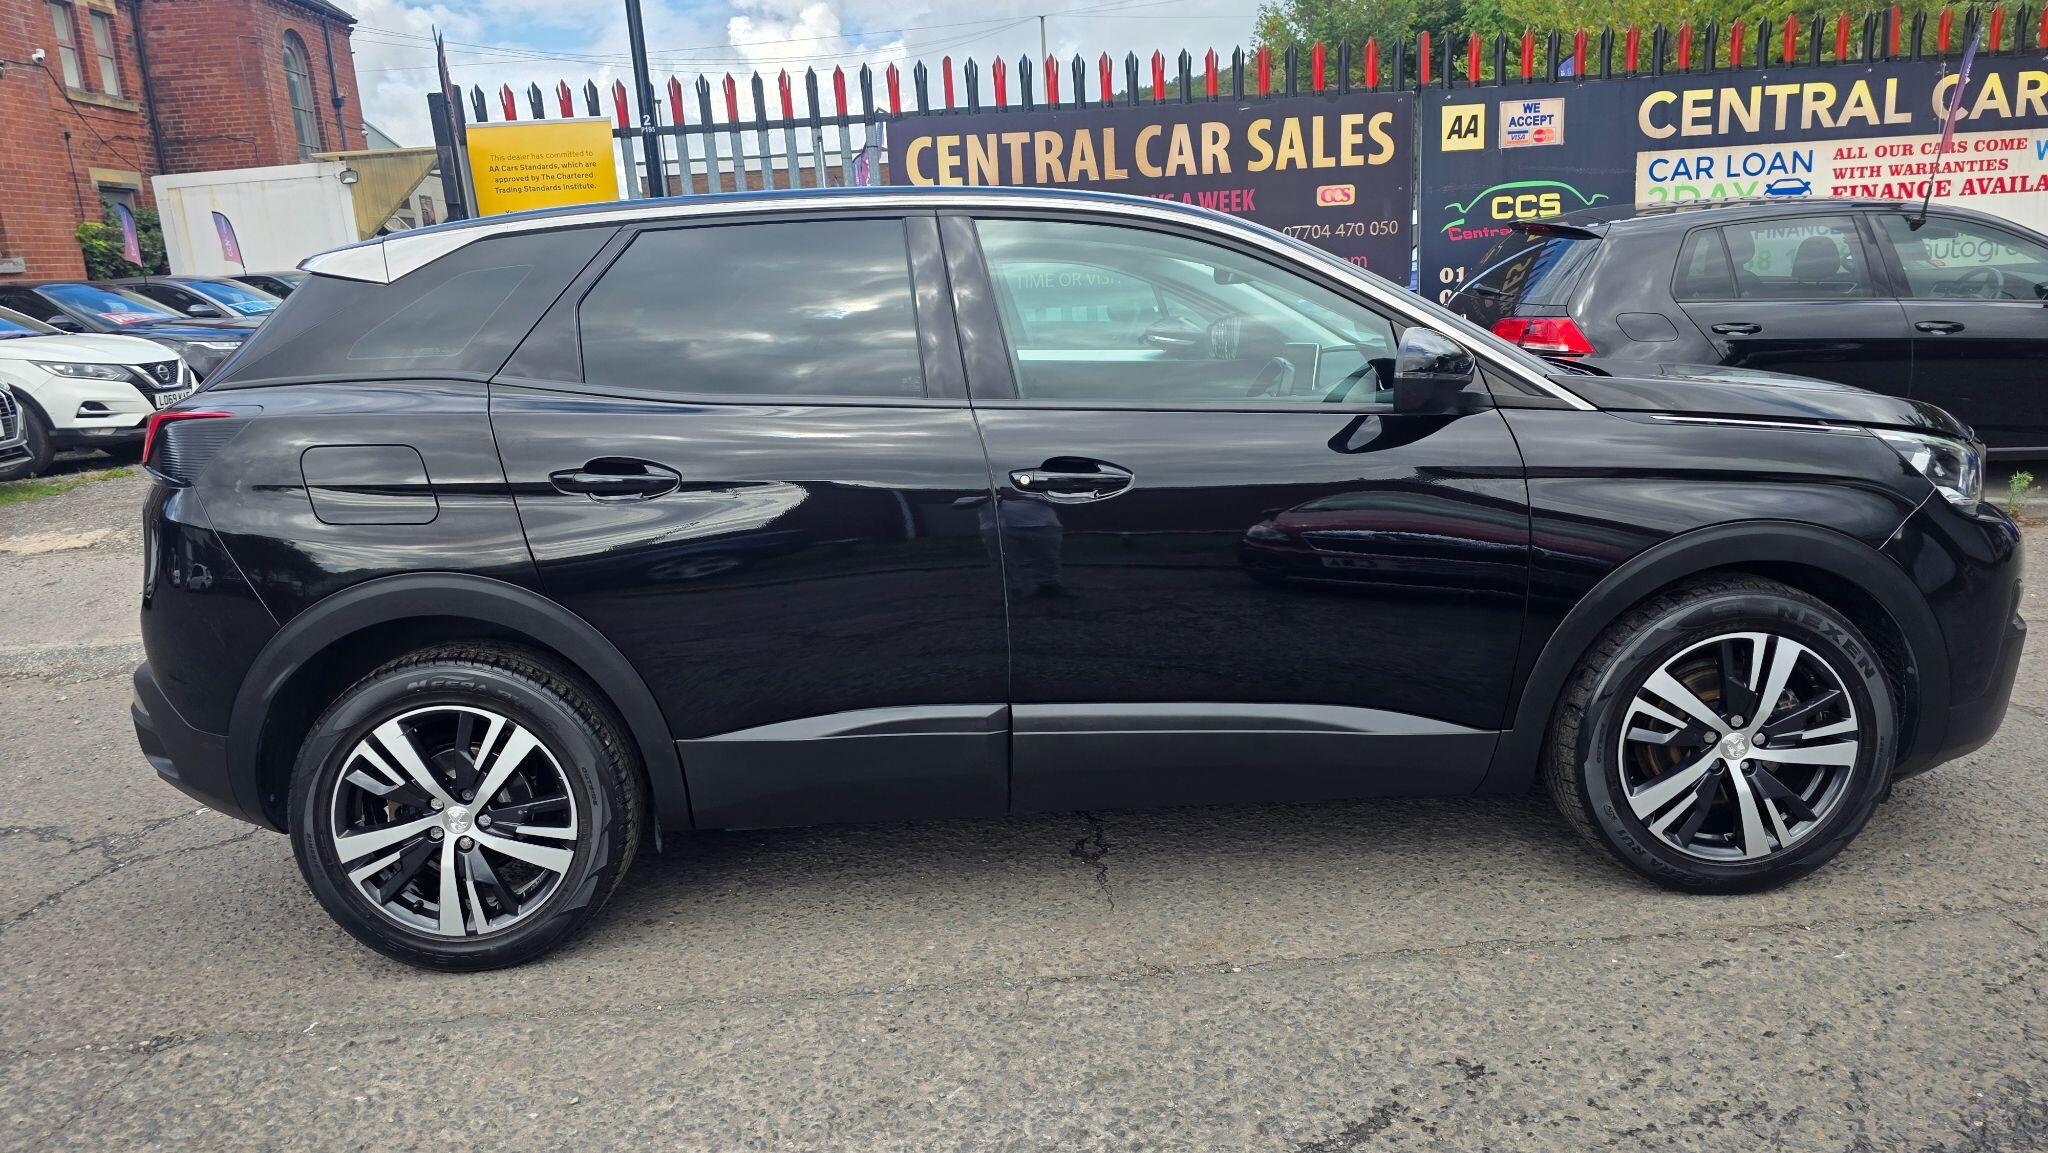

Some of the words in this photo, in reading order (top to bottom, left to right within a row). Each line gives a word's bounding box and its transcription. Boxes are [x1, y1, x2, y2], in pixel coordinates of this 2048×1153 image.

[1522, 102, 1541, 114] WE
[1638, 77, 1913, 140] CENTRAL
[1931, 70, 2048, 121] CAR
[642, 114, 651, 126] 2
[1446, 114, 1479, 140] AA
[1508, 114, 1554, 127] ACCEPT
[1510, 133, 1526, 141] VISA
[489, 153, 506, 162] This
[506, 152, 530, 162] dealer
[531, 151, 545, 160] has
[545, 150, 585, 160] committed
[905, 127, 1129, 187] CENTRAL
[1134, 121, 1232, 178] CAR
[1246, 111, 1395, 173] SALES
[1832, 146, 1868, 161] ALL
[1874, 143, 1915, 158] OUR
[1973, 137, 2028, 153] COME
[489, 164, 500, 173] AA
[501, 163, 518, 172] Cars
[519, 161, 560, 172] Standards,
[561, 160, 584, 170] which
[1648, 156, 1714, 182] CAR
[1726, 149, 1814, 177] LOAN
[1832, 165, 1882, 180] WITH
[1888, 158, 2009, 177] WARRANTIES
[494, 173, 530, 184] approved
[530, 173, 540, 183] by
[541, 173, 555, 181] The
[556, 171, 594, 181] Chartered
[494, 186, 522, 195] Trading
[523, 183, 562, 193] Standards
[562, 182, 597, 191] Institute.
[1831, 179, 1952, 200] FINANCE
[1197, 188, 1256, 213] WEEK
[1491, 192, 1561, 220] CCS
[1282, 224, 1331, 240] 07704
[1334, 222, 1365, 237] 470
[1369, 220, 1399, 236] 050
[1017, 272, 1055, 289] TIME
[1059, 272, 1082, 288] OR
[1777, 604, 1877, 680] NEXEN
